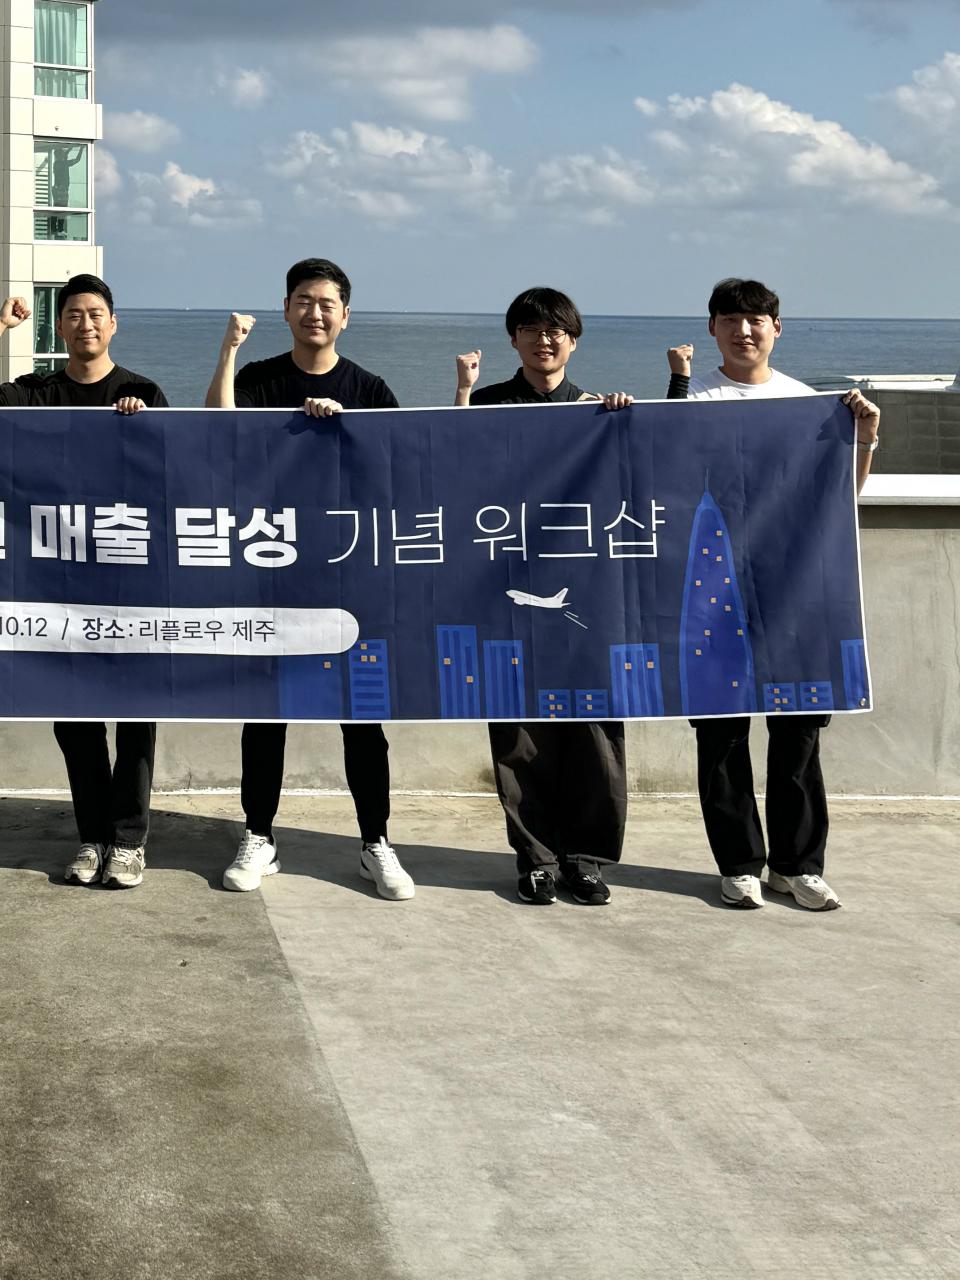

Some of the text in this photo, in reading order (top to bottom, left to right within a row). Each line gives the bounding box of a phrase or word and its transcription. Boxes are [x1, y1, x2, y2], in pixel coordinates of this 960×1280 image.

[30, 502, 151, 565] 매출
[175, 507, 298, 568] 달성
[325, 505, 444, 567] 기념
[472, 499, 666, 561] 워크샵
[139, 619, 226, 642] 리플로우
[232, 619, 276, 643] 제주
